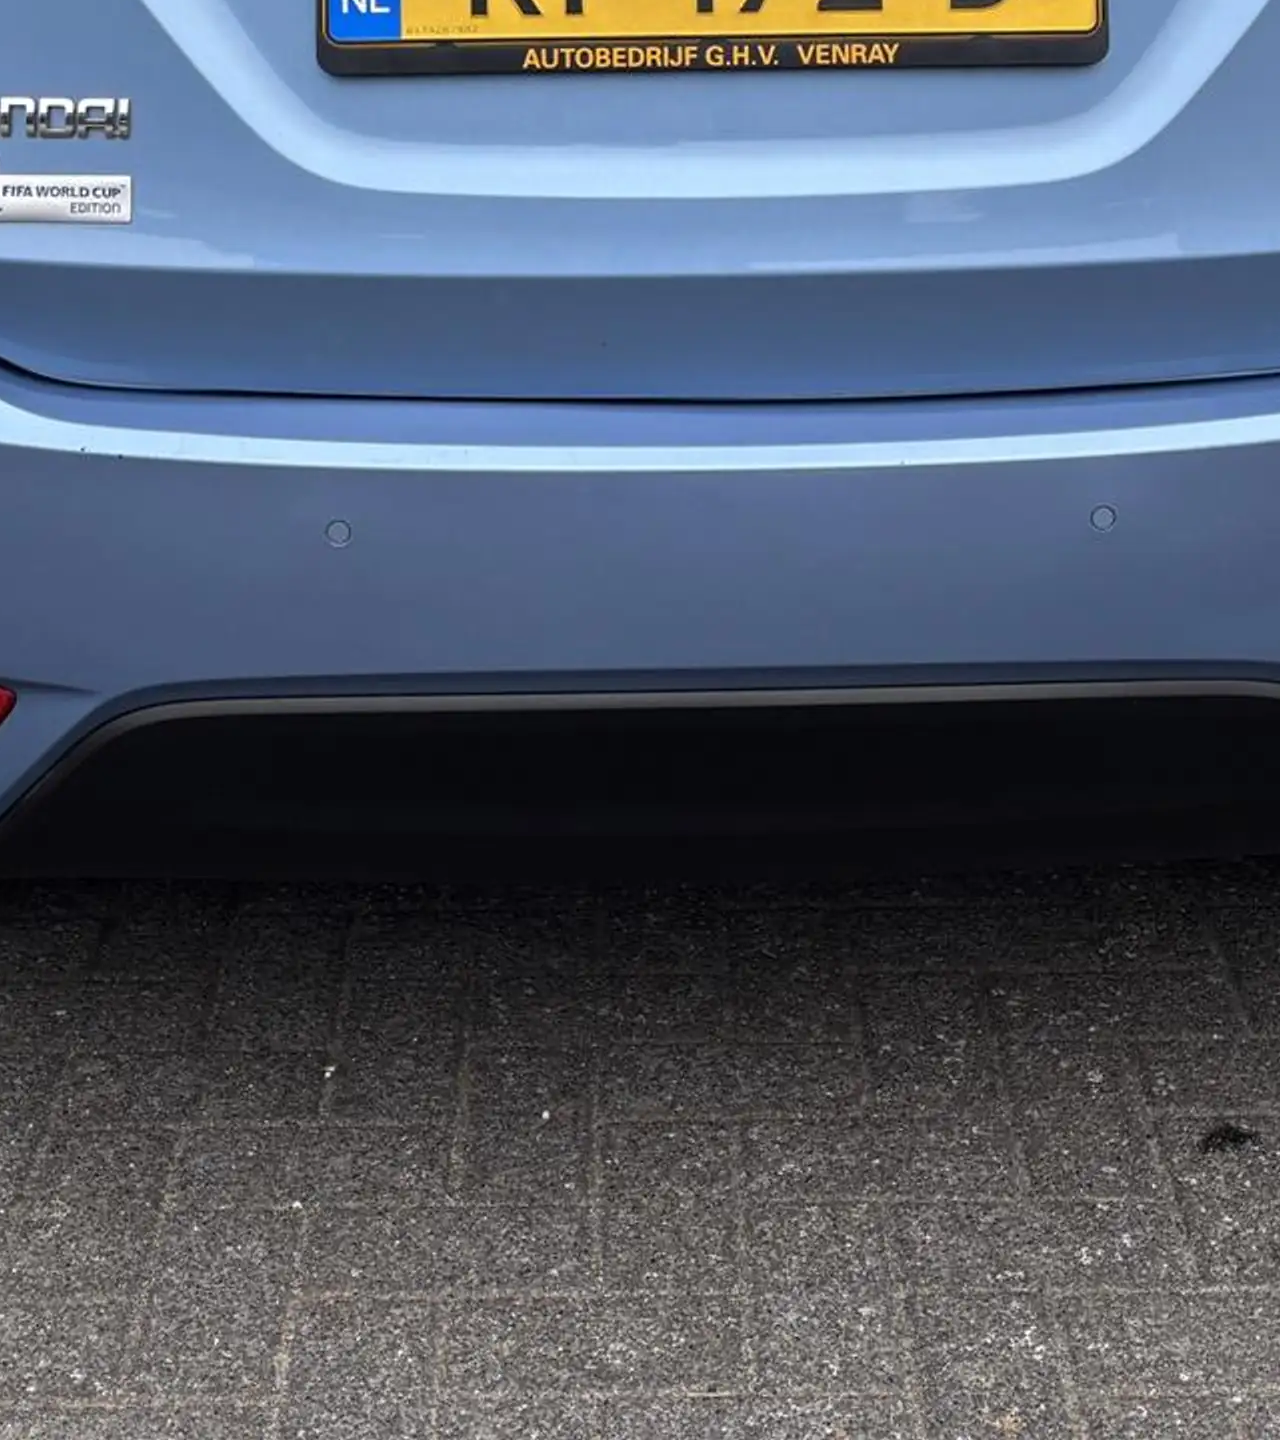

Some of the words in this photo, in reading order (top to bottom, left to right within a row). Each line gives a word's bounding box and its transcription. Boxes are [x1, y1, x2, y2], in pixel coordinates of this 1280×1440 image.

[522, 46, 697, 68] AUTOBEDRIJF
[705, 45, 778, 66] G.H.V.
[797, 43, 900, 65] VENRAY
[2, 185, 33, 198] FIFA
[36, 185, 89, 198] WORLD
[70, 202, 121, 214] EDITION
